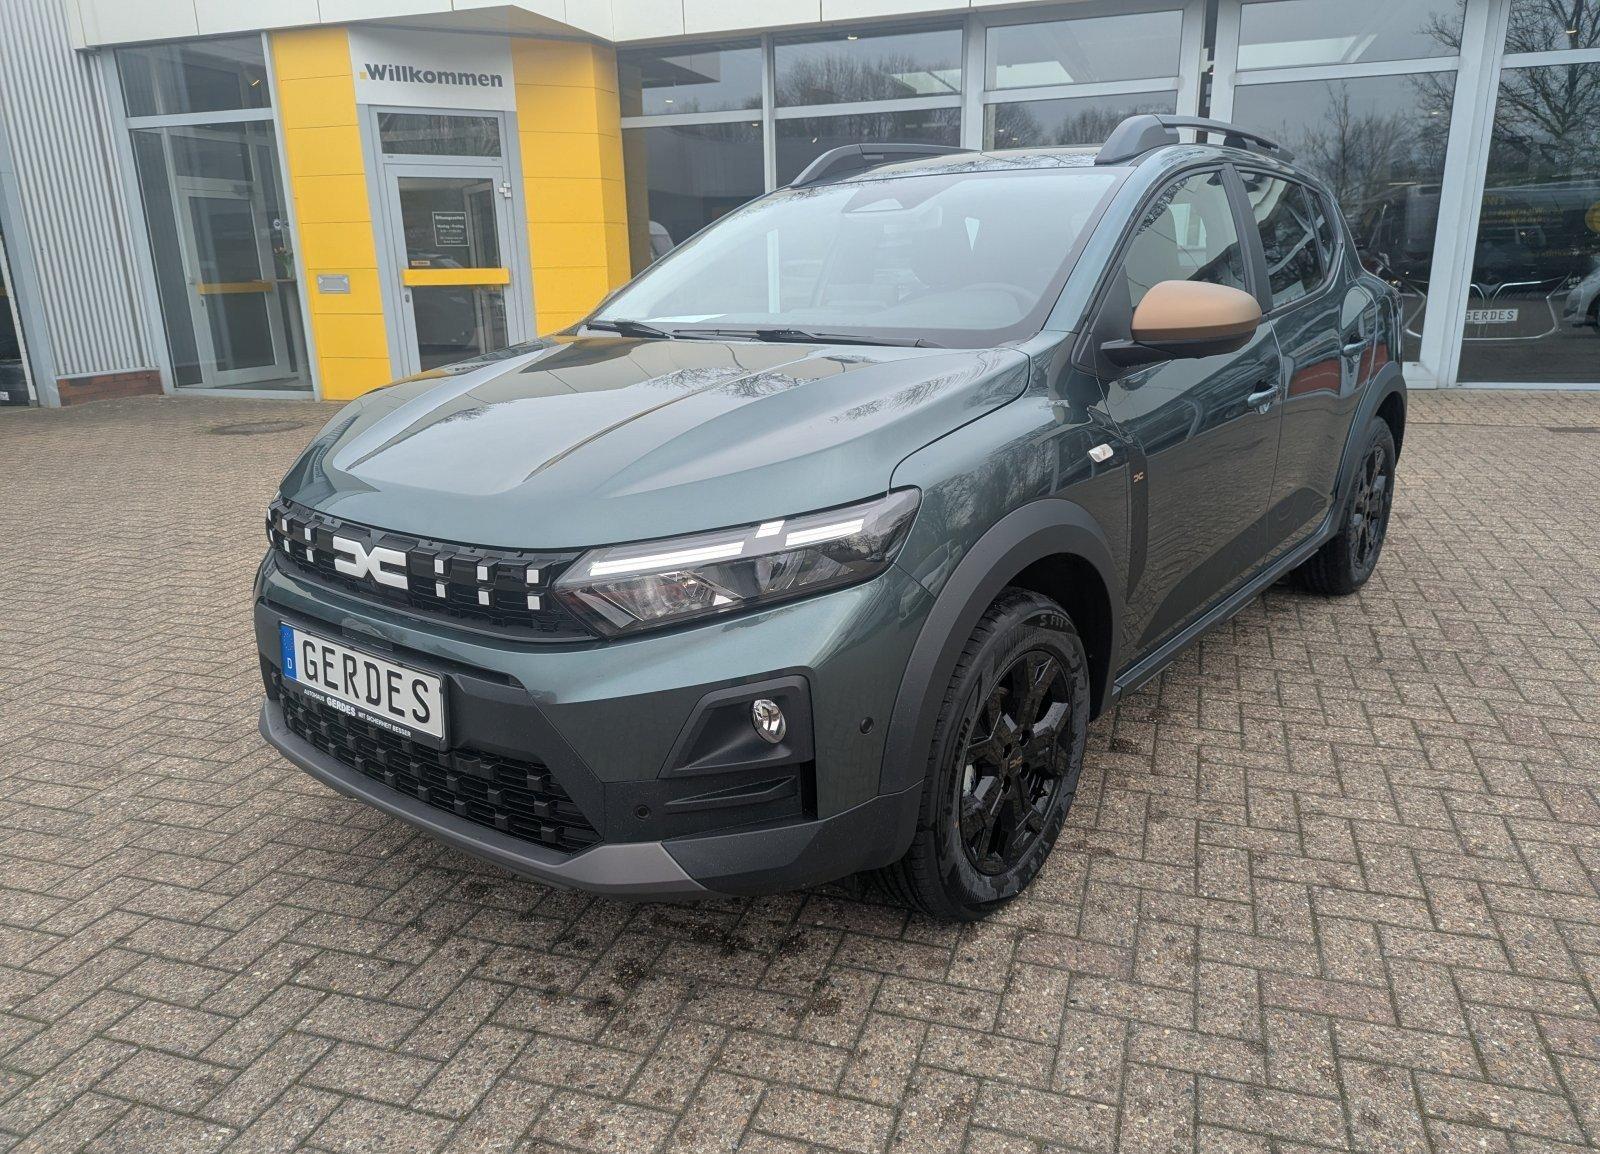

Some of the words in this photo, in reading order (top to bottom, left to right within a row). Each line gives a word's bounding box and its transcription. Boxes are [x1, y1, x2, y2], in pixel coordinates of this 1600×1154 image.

[364, 63, 503, 88] Willkommen
[287, 657, 293, 669] D
[302, 639, 431, 724] GERDES
[326, 696, 356, 717] GERDES
